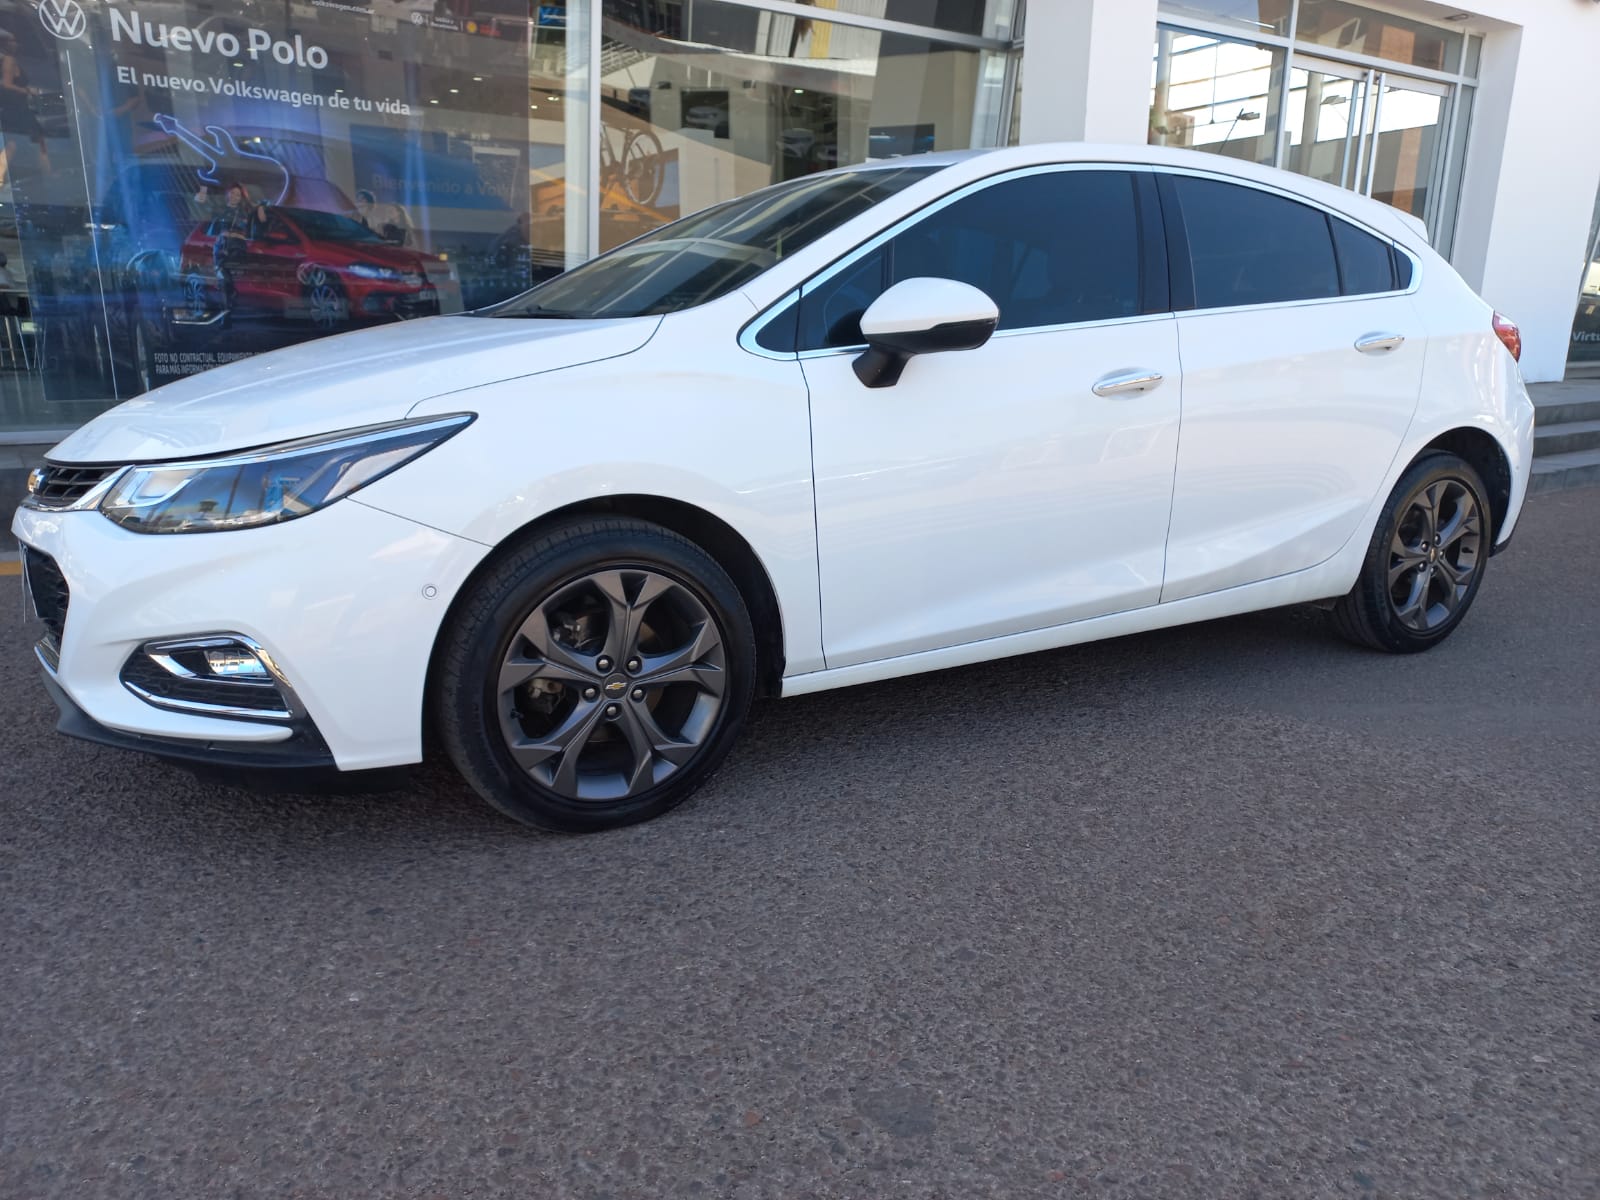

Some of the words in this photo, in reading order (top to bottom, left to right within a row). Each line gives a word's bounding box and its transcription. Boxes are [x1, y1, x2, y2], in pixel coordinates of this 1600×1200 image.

[109, 7, 240, 57] Nuevo
[247, 28, 329, 70] Polo
[117, 65, 139, 86] El
[143, 72, 206, 93] nuevo
[208, 76, 324, 108] Volkswagen
[328, 93, 350, 109] de
[353, 98, 372, 112] tu
[375, 97, 412, 116] vida
